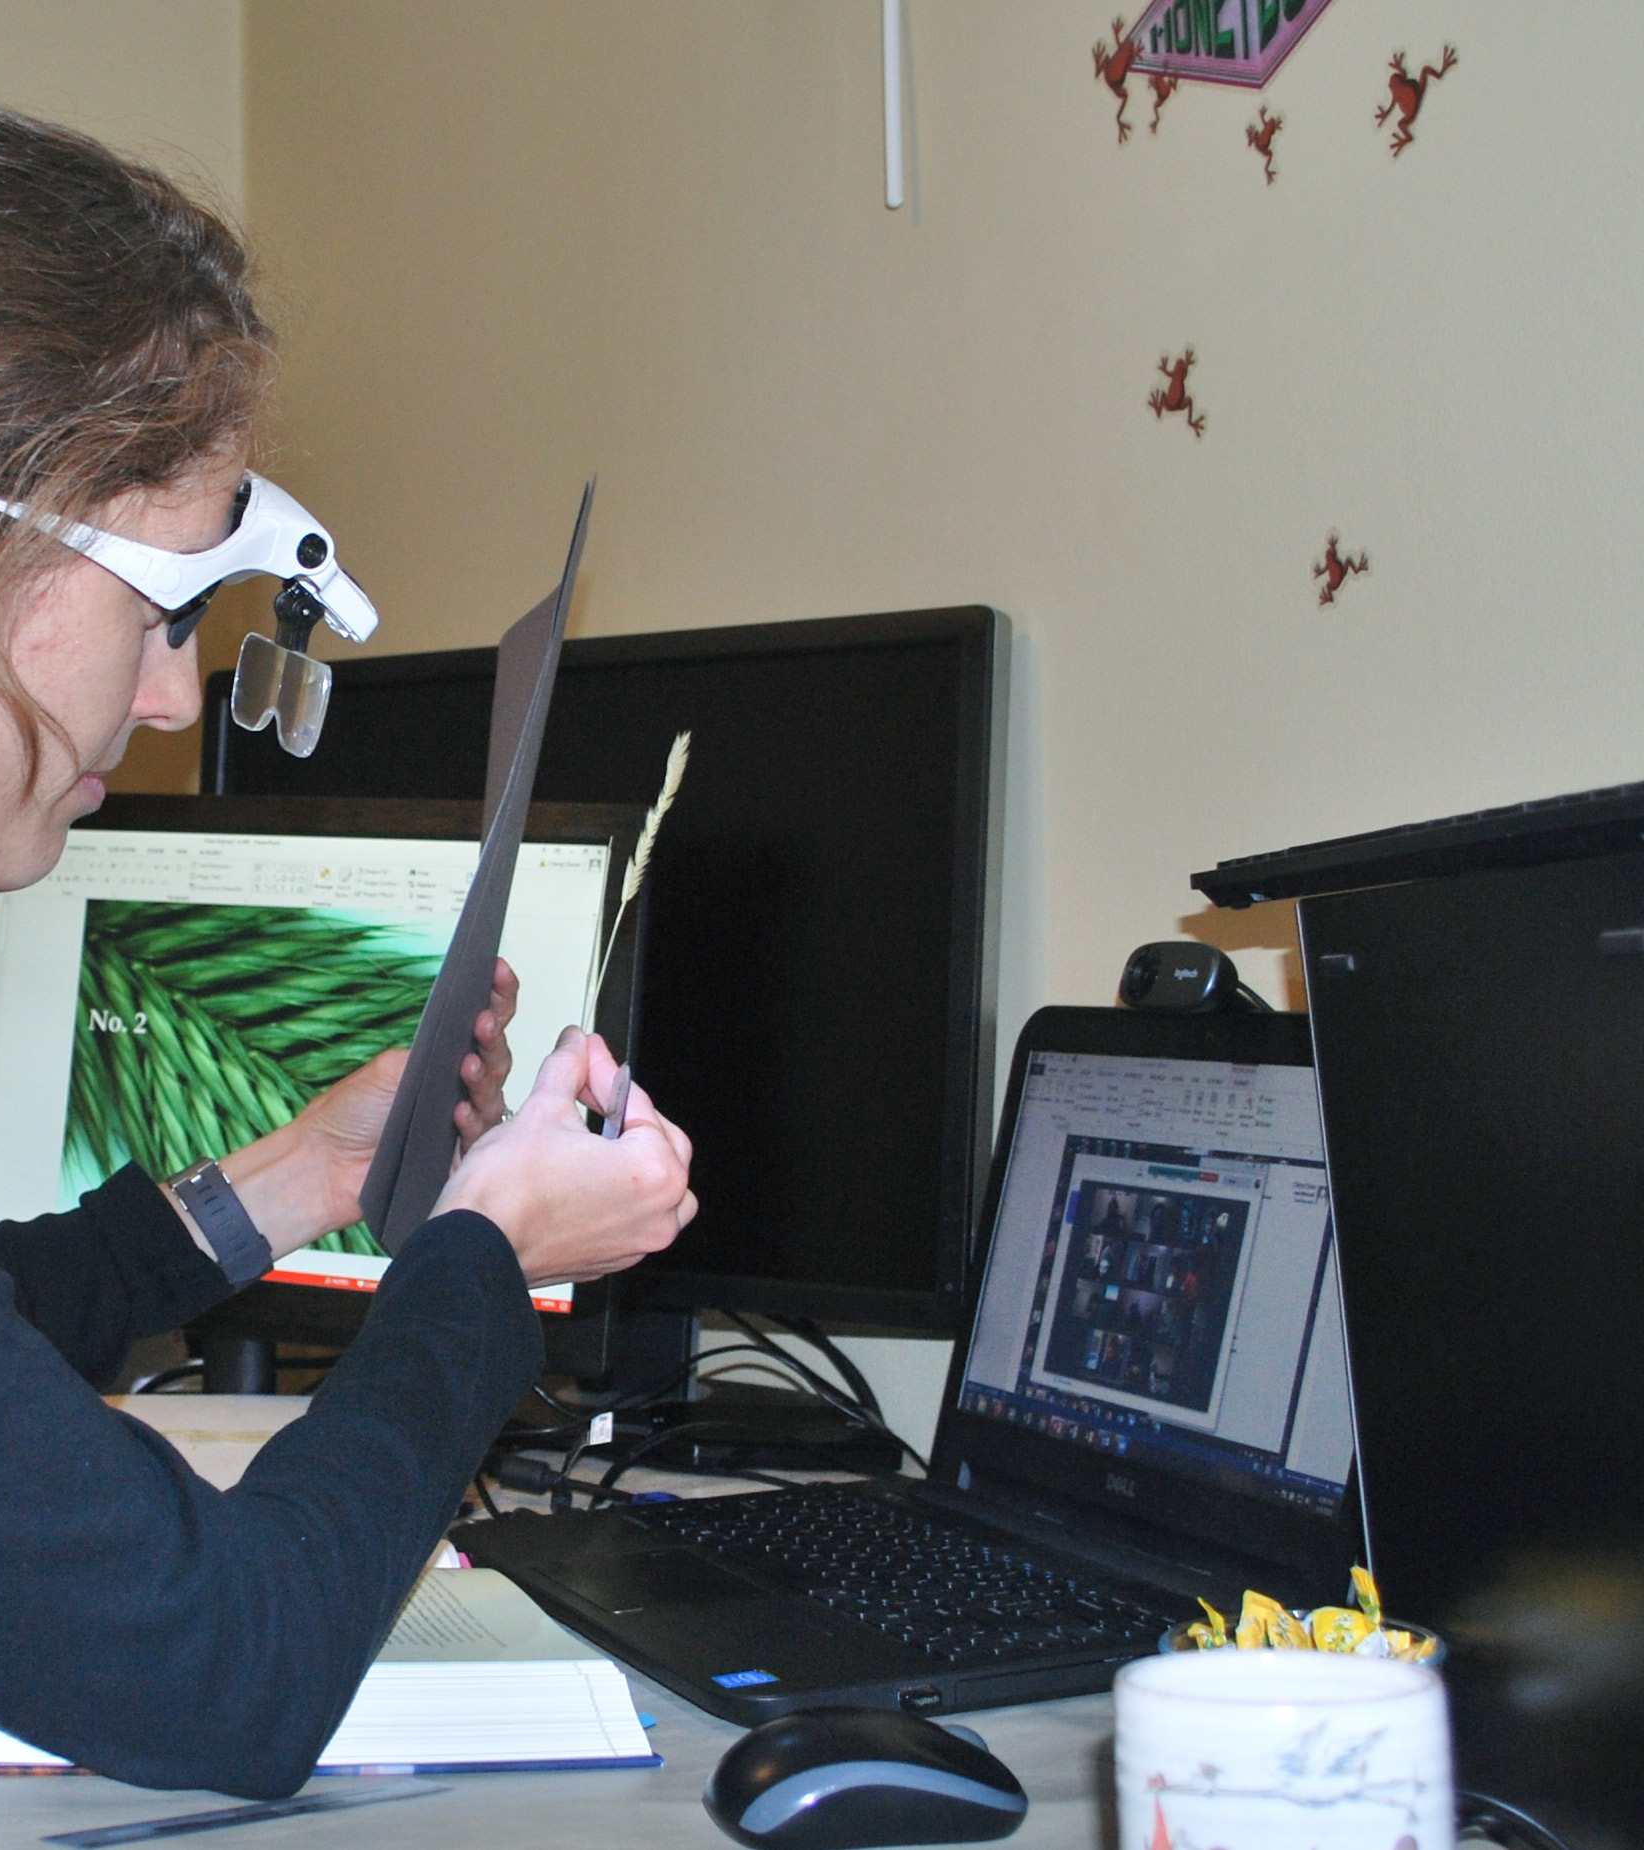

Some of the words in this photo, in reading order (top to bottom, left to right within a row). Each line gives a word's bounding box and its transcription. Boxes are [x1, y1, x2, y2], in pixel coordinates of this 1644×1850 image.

[1150, 0, 1307, 60] HONE
[88, 1008, 128, 1033] No.
[132, 1011, 148, 1034] 2
[1105, 1473, 1136, 1497] DELL
